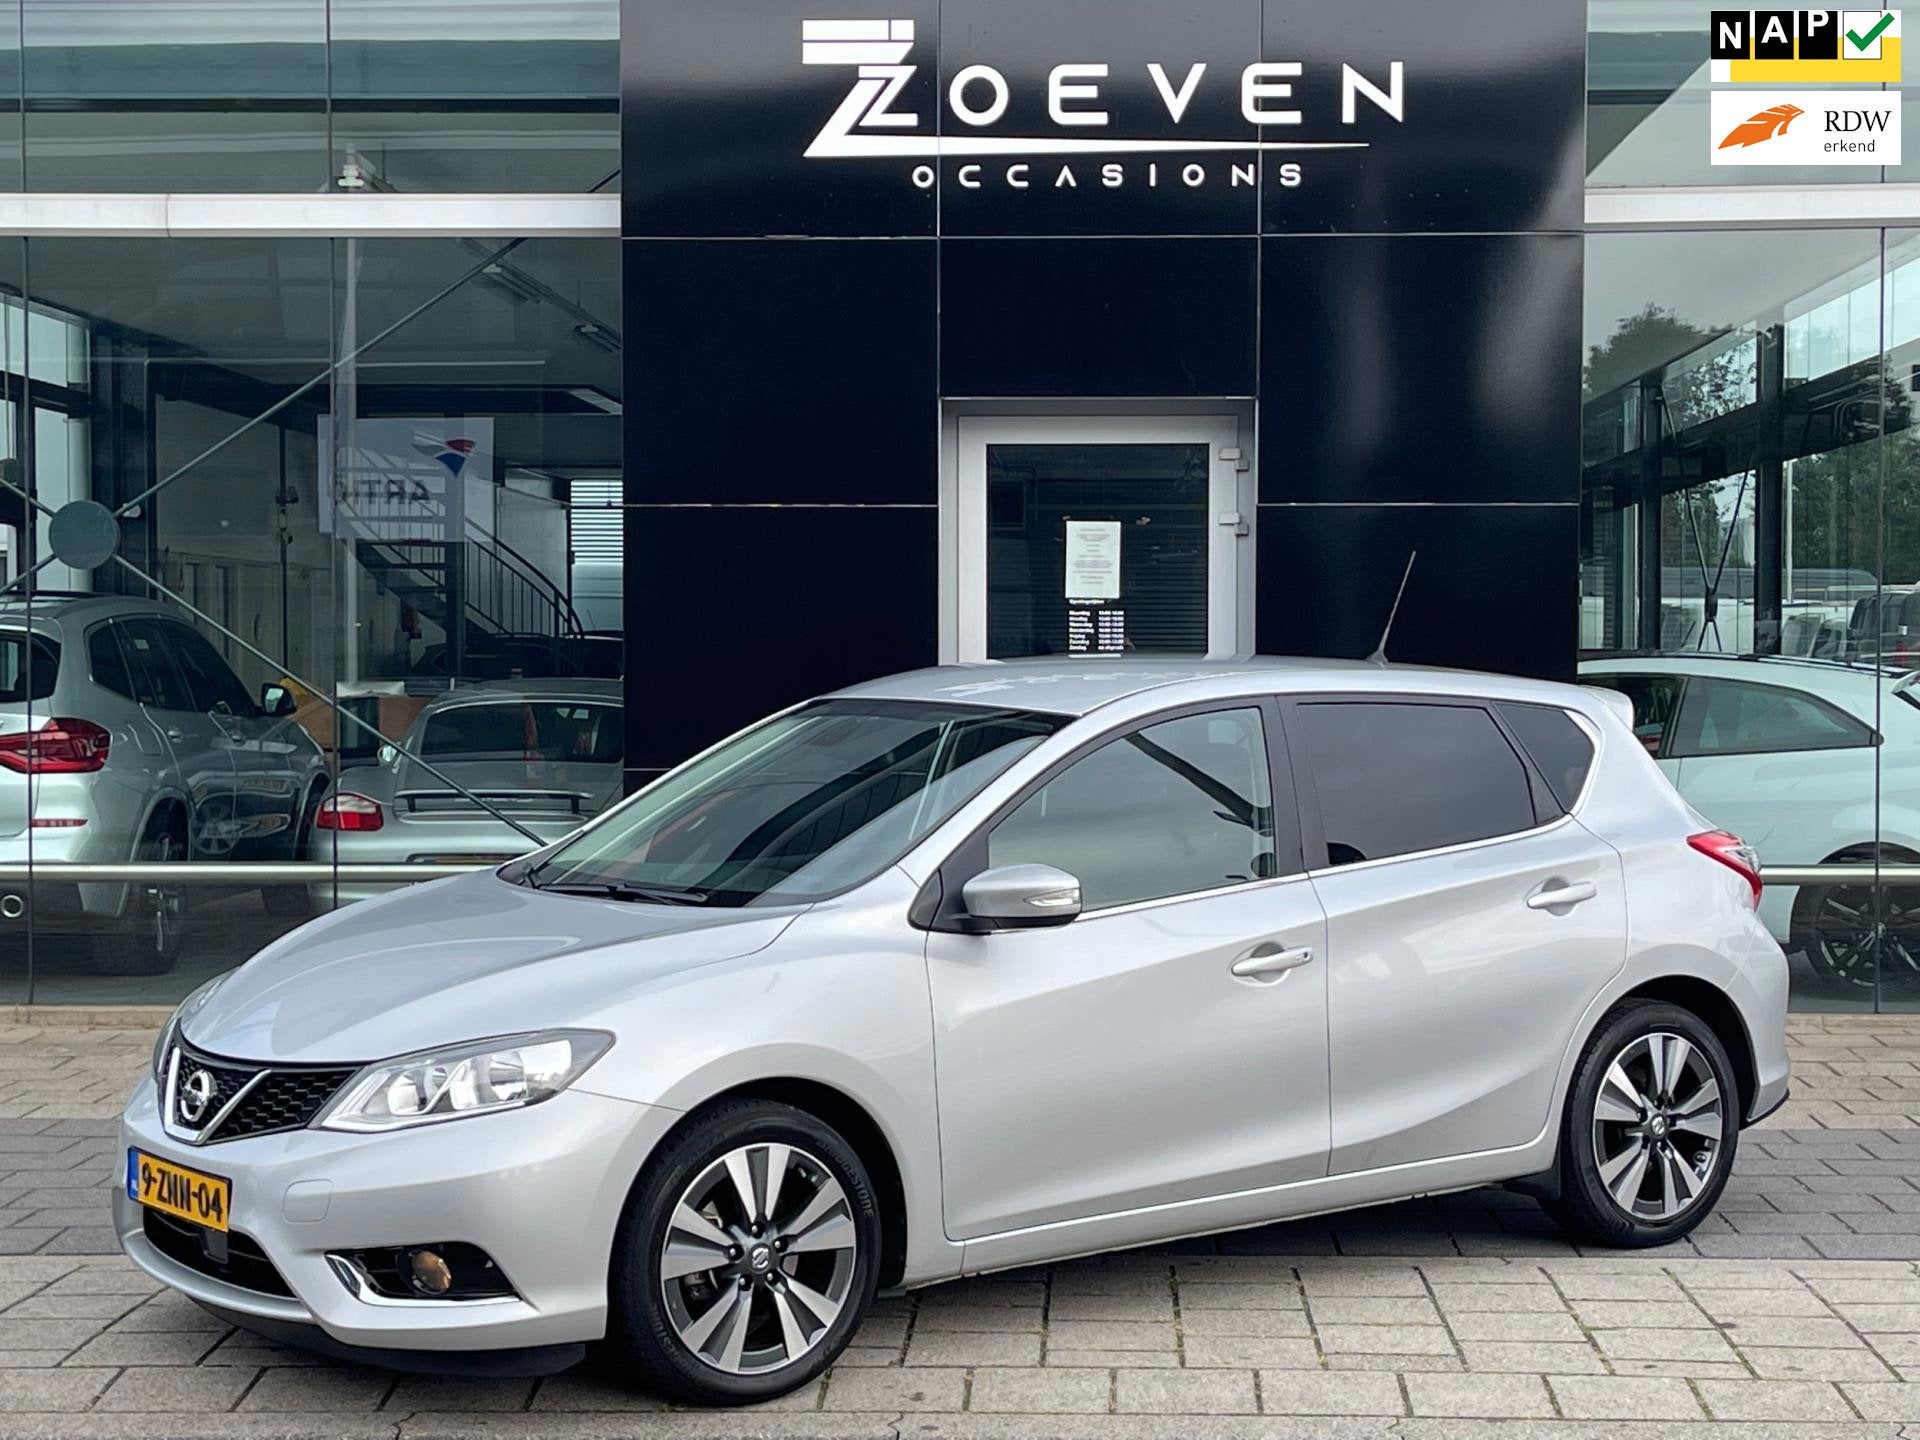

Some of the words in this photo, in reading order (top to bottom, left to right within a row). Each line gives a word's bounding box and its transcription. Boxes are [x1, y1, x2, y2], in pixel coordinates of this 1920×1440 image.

[857, 61, 1404, 127] ZOEVEN
[912, 163, 1302, 189] OCCASIONS
[142, 1162, 223, 1223] 9-ZNN-04
